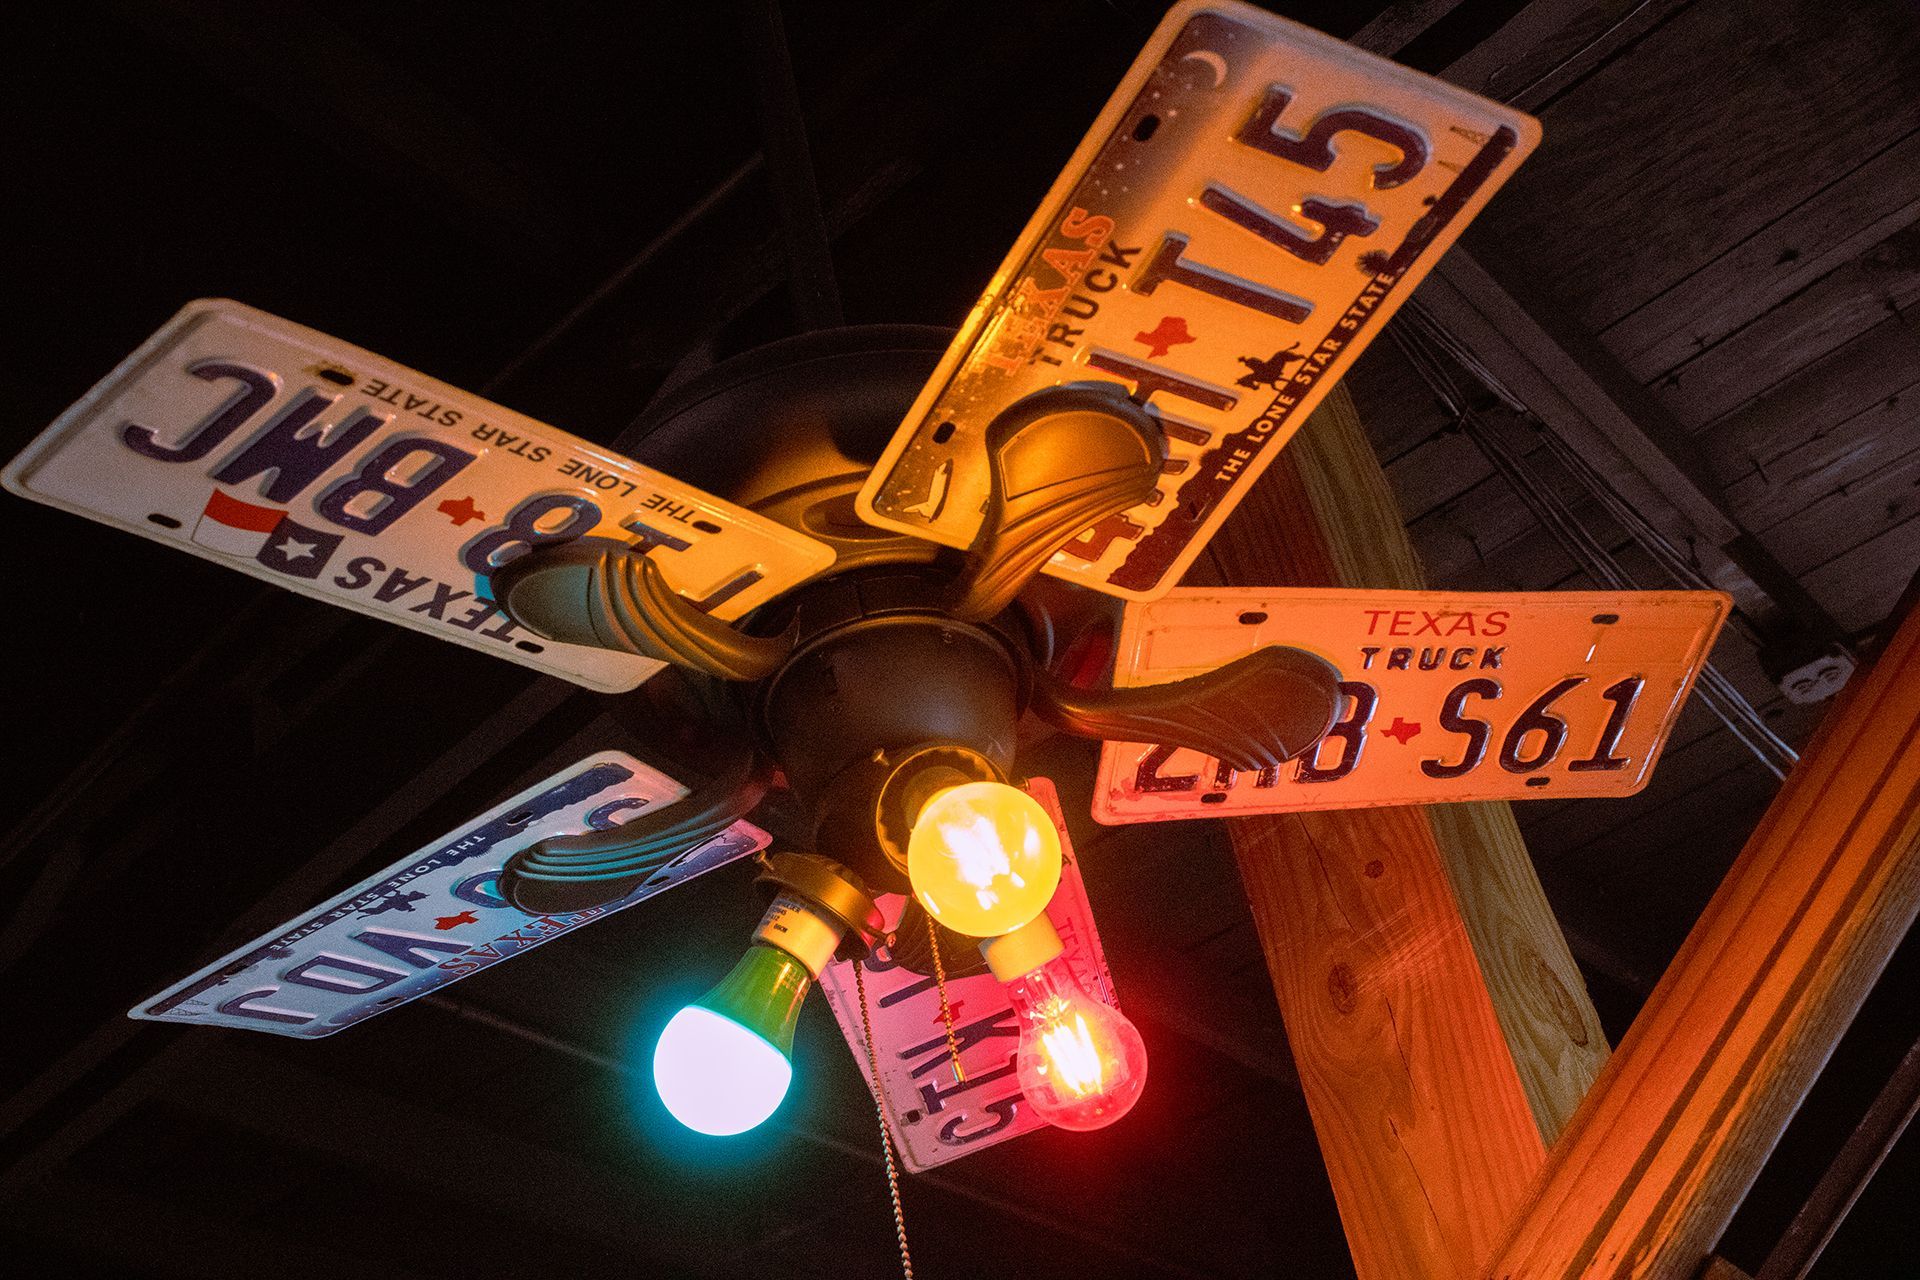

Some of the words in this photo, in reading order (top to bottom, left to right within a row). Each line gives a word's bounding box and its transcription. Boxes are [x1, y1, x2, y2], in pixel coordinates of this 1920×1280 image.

[1131, 82, 1432, 324] T45
[986, 206, 1116, 377] TEXAS
[1028, 240, 1141, 366] TRUCK
[1215, 448, 1251, 481] THE
[1247, 394, 1296, 442] LONE
[1295, 338, 1342, 385] STAR
[1340, 272, 1394, 330] STATE
[360, 377, 465, 428] STATE
[122, 359, 480, 537] BMC
[471, 421, 552, 463] STAR
[558, 457, 638, 498] LONE
[639, 492, 698, 525] THE
[334, 556, 520, 643] TEXAS
[1363, 609, 1510, 636] TEXAS
[1361, 646, 1507, 670] TRUCK
[1420, 673, 1645, 779] S61
[446, 835, 487, 857] THE
[388, 858, 441, 888] LONE
[330, 892, 376, 920] STAR
[269, 921, 325, 951] STATE
[220, 927, 474, 1026] VDJ
